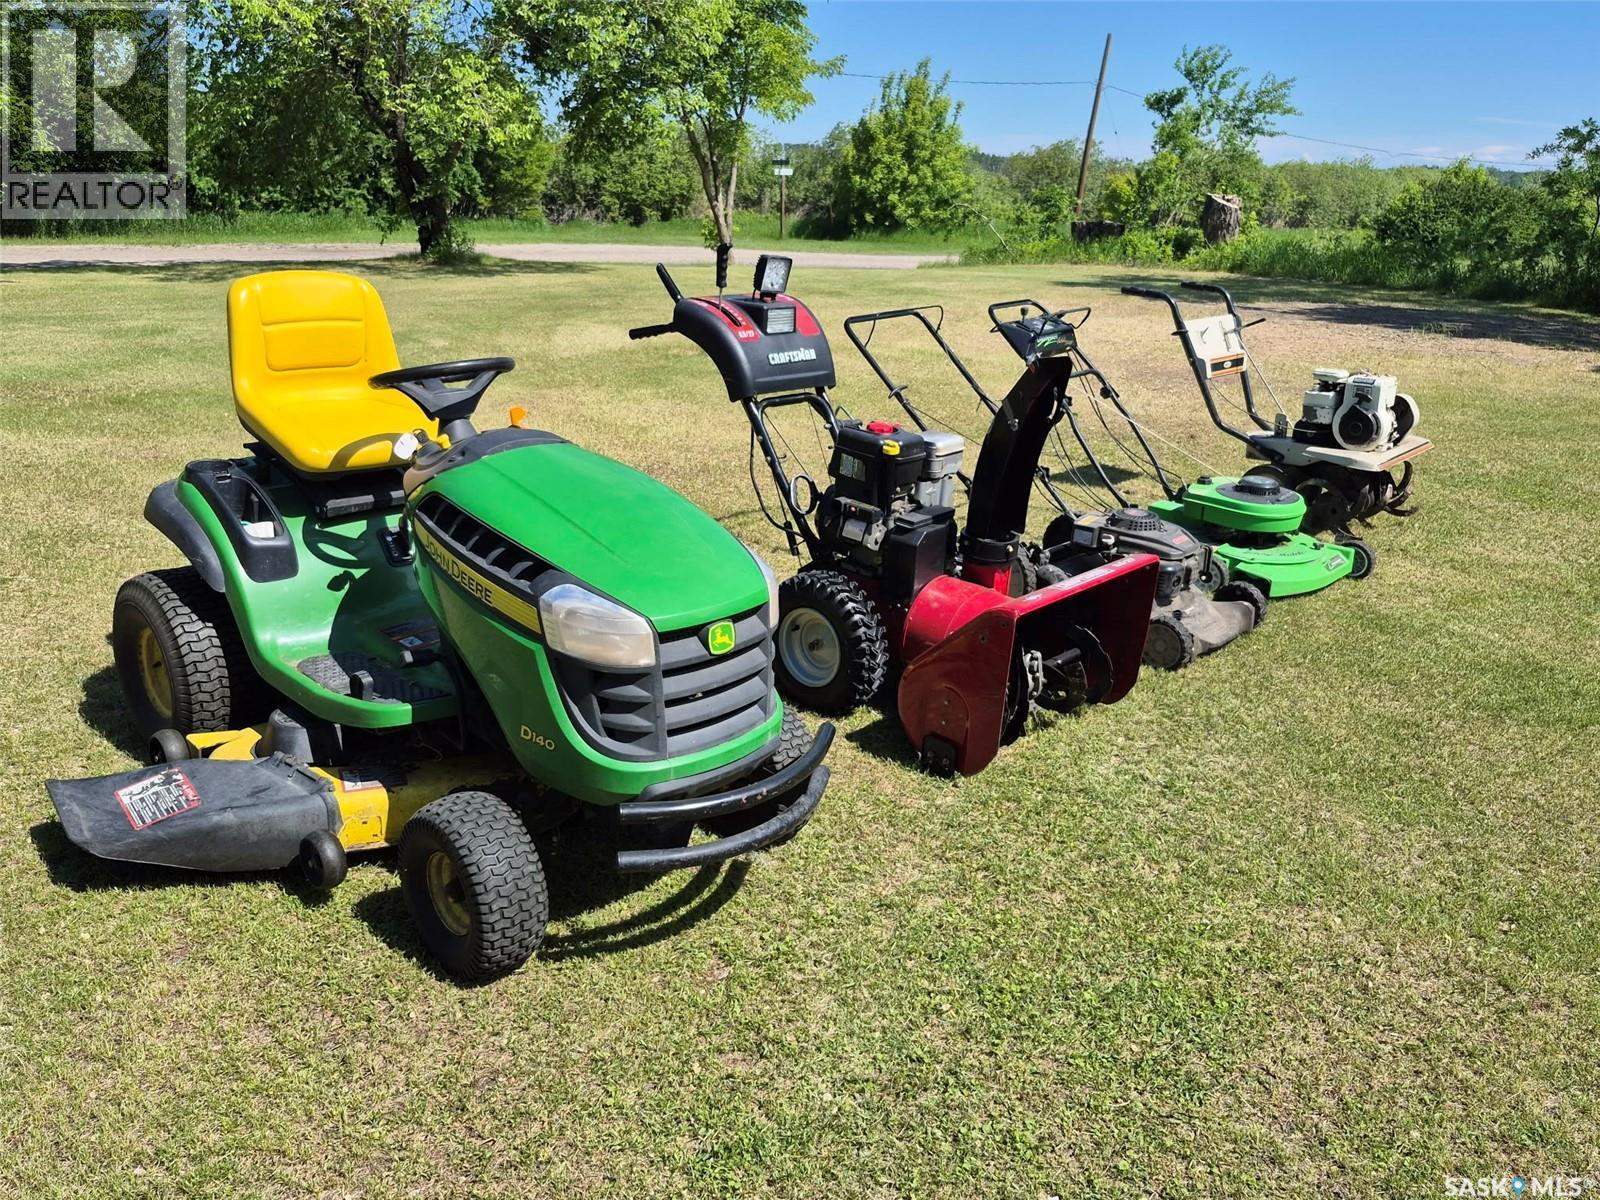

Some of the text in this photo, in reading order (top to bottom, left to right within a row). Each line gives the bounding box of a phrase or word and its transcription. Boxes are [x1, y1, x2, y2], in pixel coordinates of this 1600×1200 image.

[768, 347, 816, 365] CRAFTSMAN
[425, 534, 493, 605] JOHN DEERE
[520, 724, 555, 750] D140
